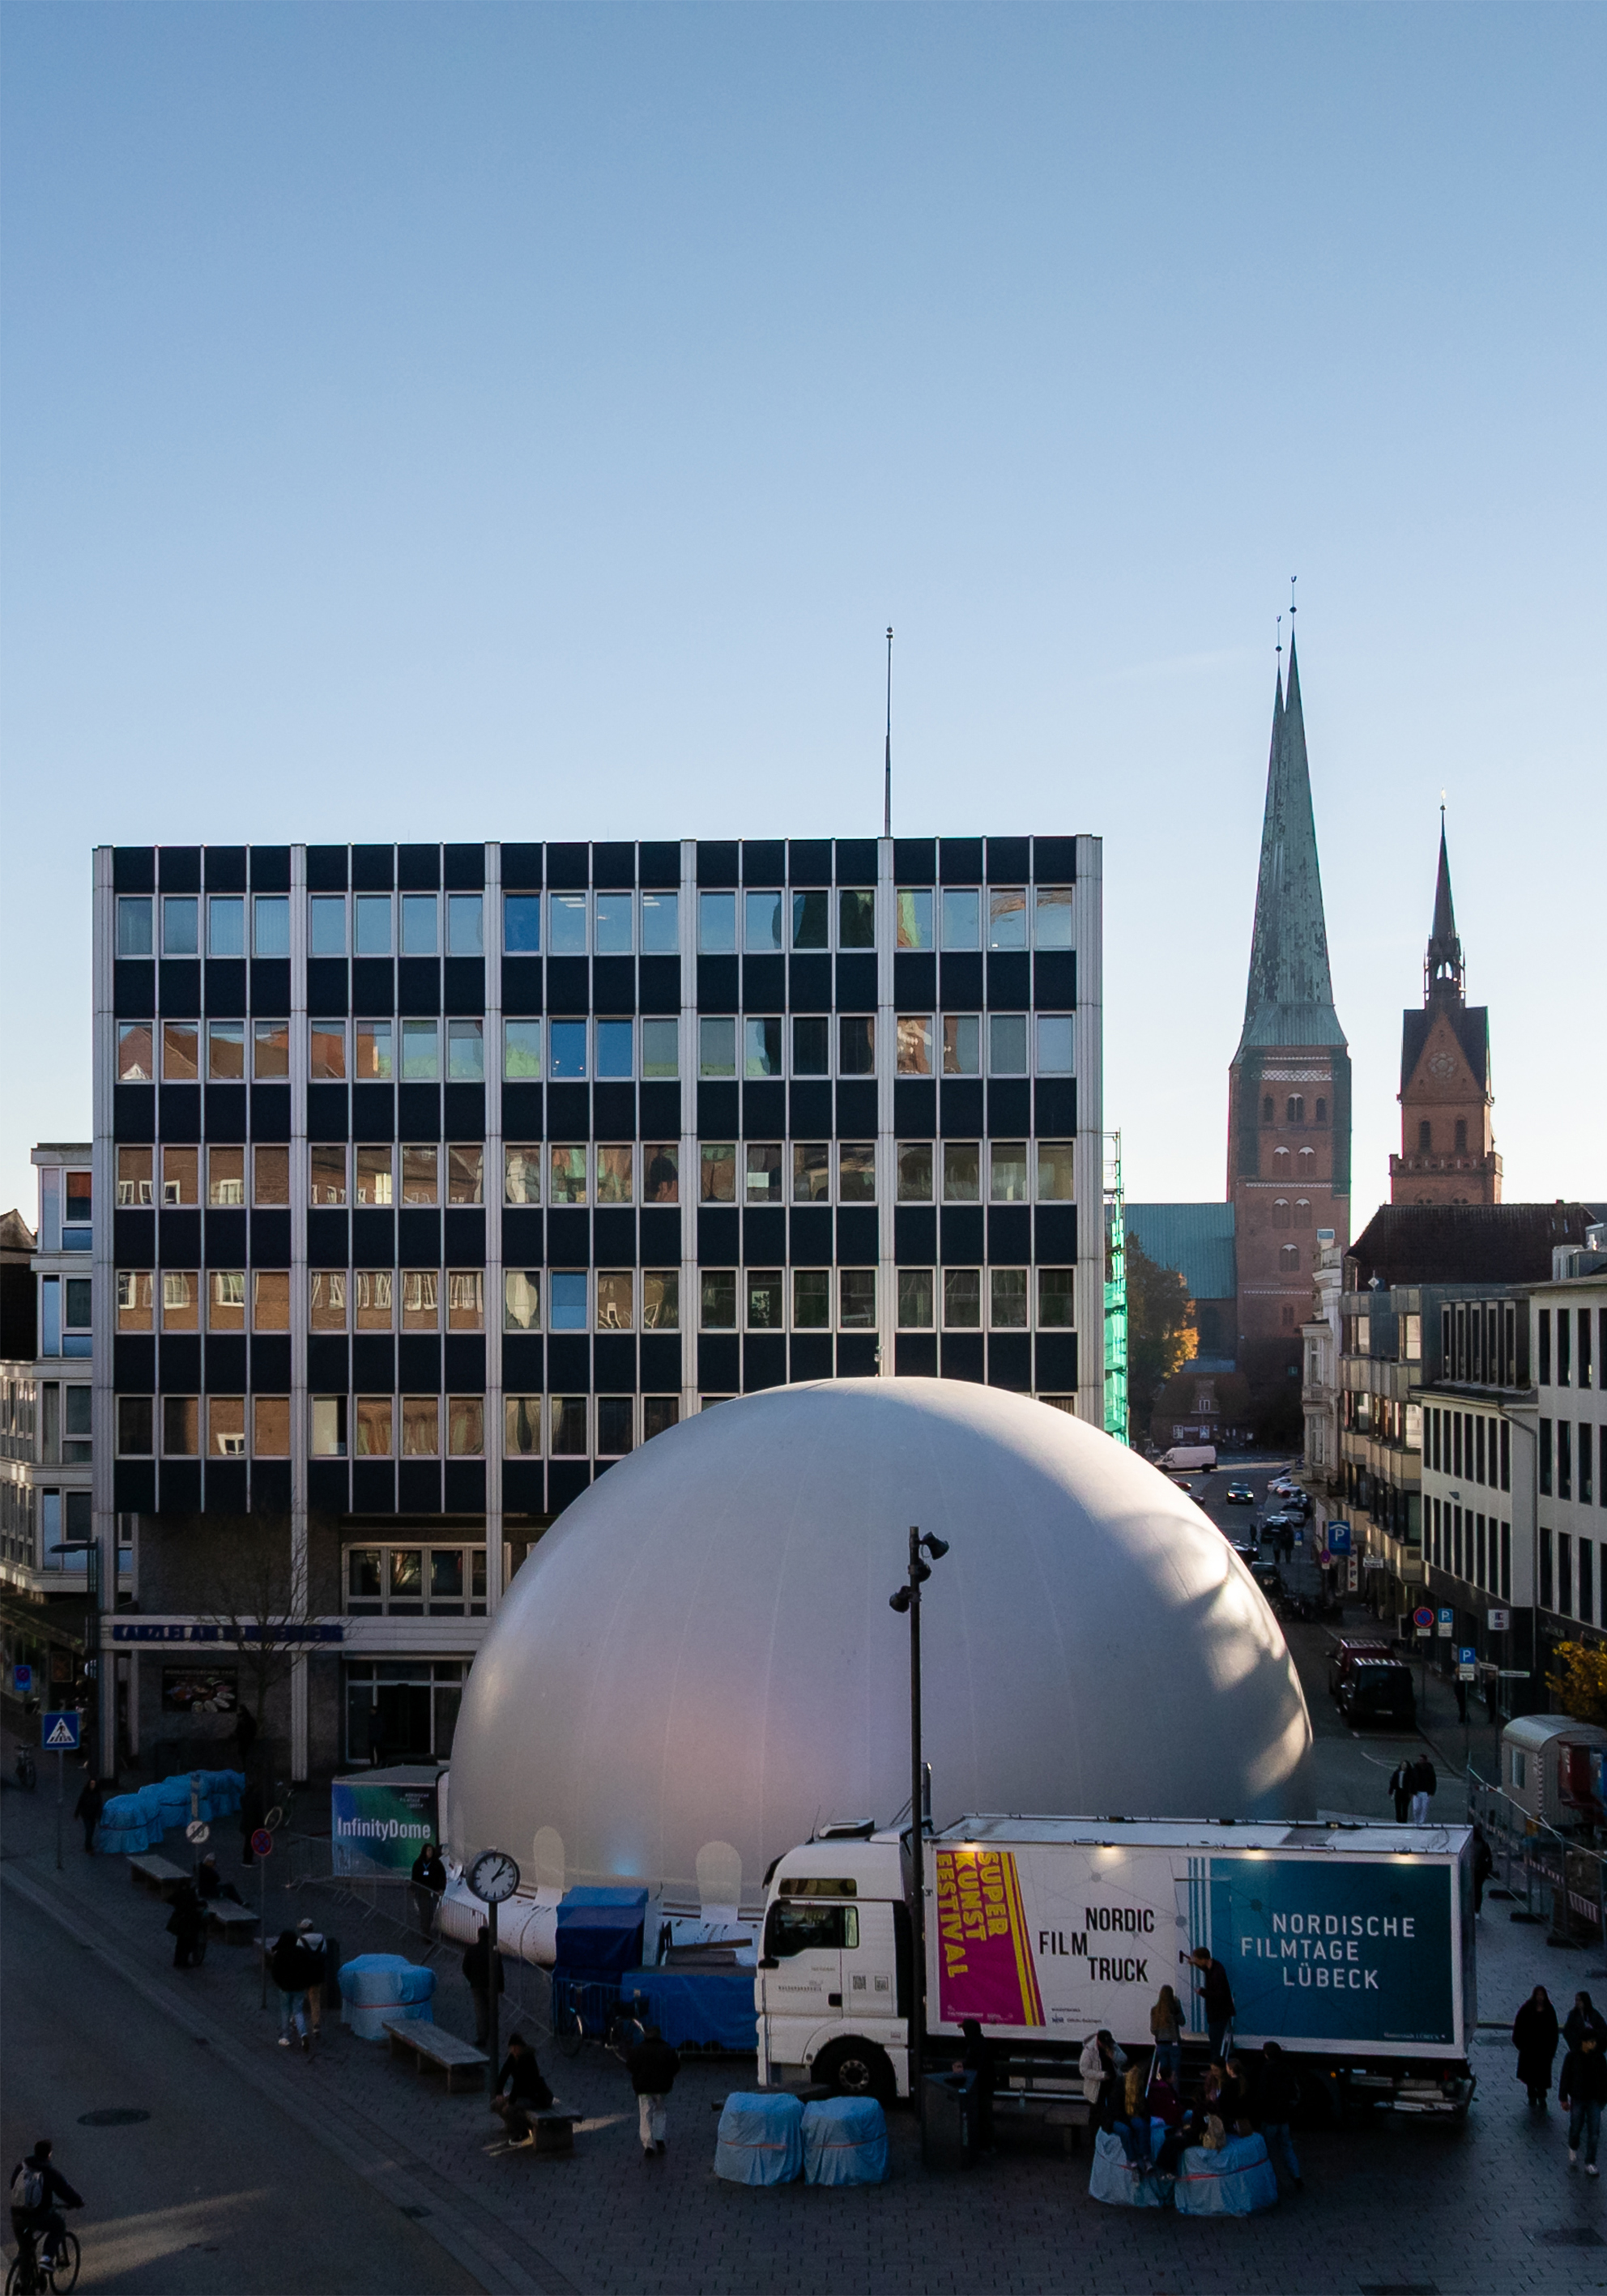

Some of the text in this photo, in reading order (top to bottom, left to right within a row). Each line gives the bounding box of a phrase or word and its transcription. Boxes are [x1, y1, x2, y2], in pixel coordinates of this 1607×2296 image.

[1335, 1529, 1345, 1541] P
[1350, 1570, 1357, 1578] P
[1442, 1611, 1450, 1621] P
[1463, 1650, 1471, 1662] P
[337, 1817, 431, 1842] InfinityDome
[955, 1852, 987, 1942] KUNST
[977, 1851, 1008, 1936] SUPER
[937, 1854, 969, 1979] FESTIVAL
[1085, 1907, 1155, 1933] NORDIC
[1272, 1913, 1415, 1937] NORDISCHE
[1038, 1931, 1088, 1955] FILM
[1241, 1937, 1359, 1962] FILMTAGE
[1087, 1957, 1149, 1983] TRUCK
[1283, 1962, 1379, 1990] LÜBECK
